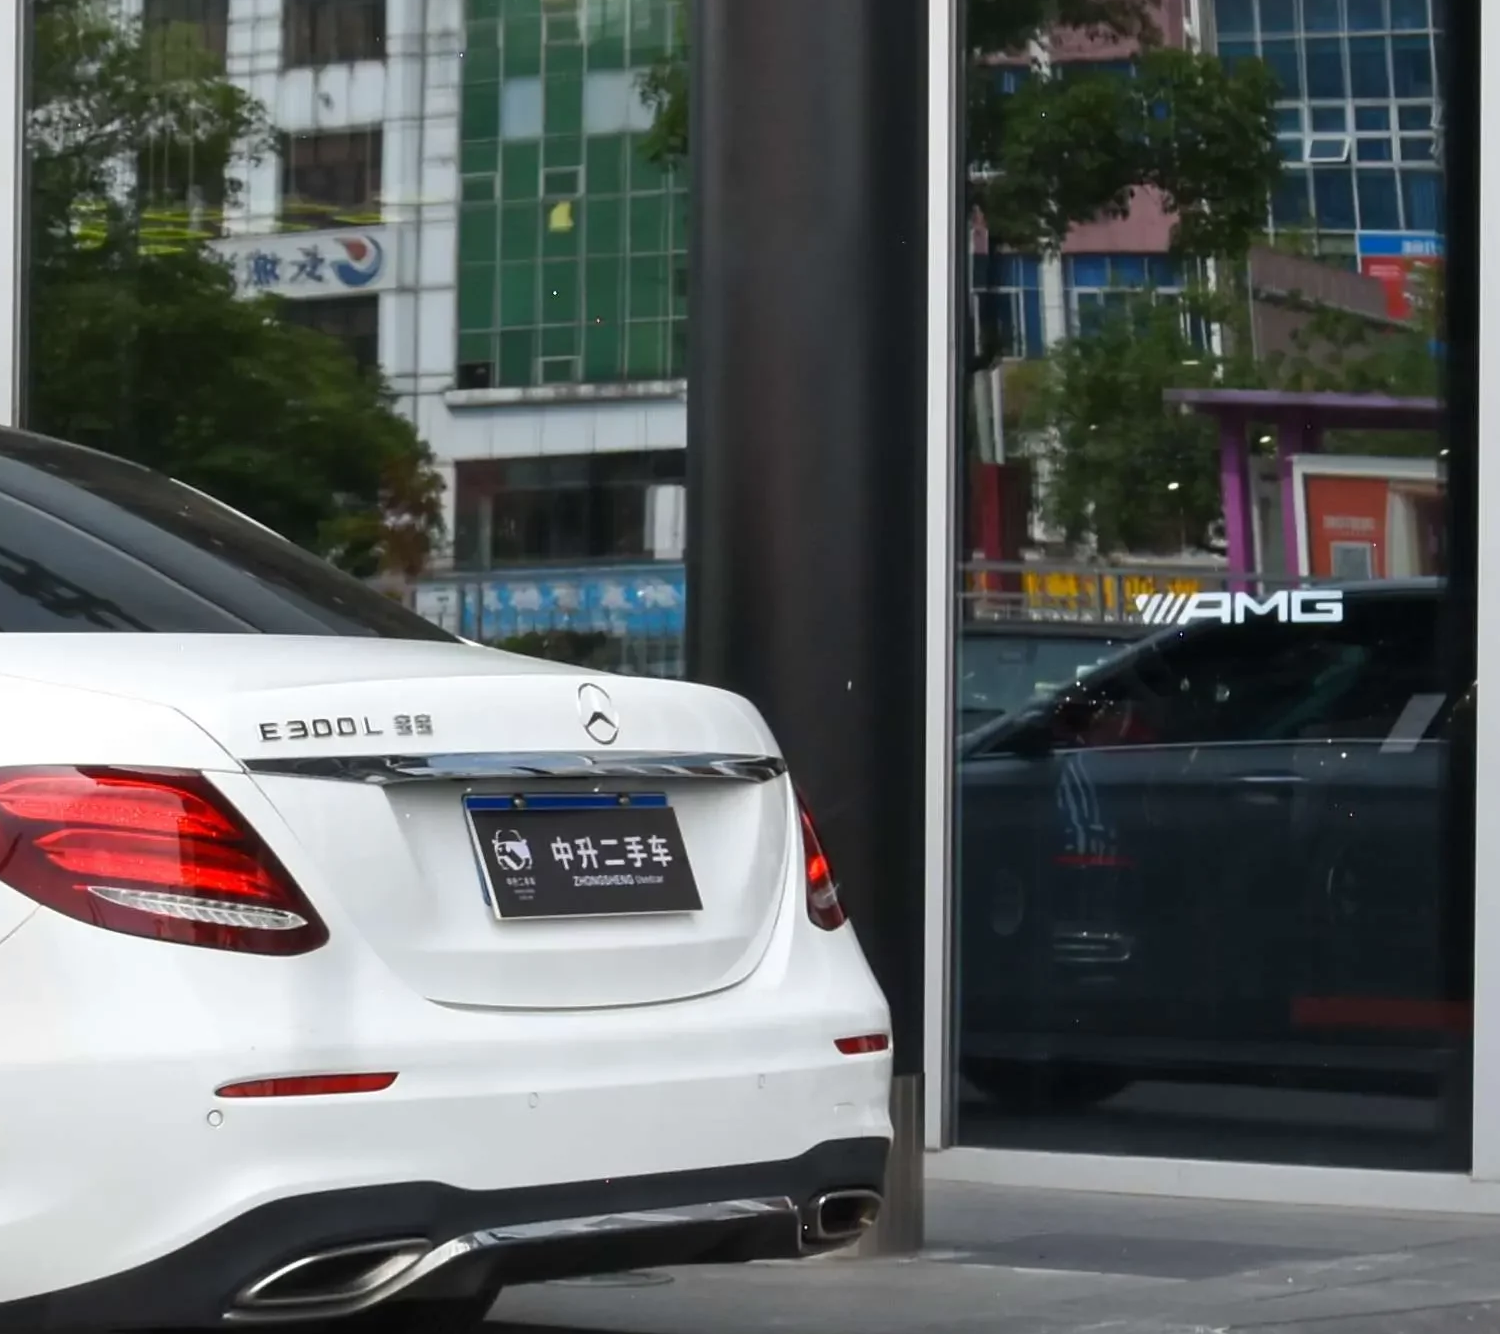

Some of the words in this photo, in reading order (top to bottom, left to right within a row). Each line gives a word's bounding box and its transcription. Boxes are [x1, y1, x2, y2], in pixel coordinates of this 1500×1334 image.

[1176, 590, 1343, 625] AMG
[551, 835, 673, 870] 中升二手车
